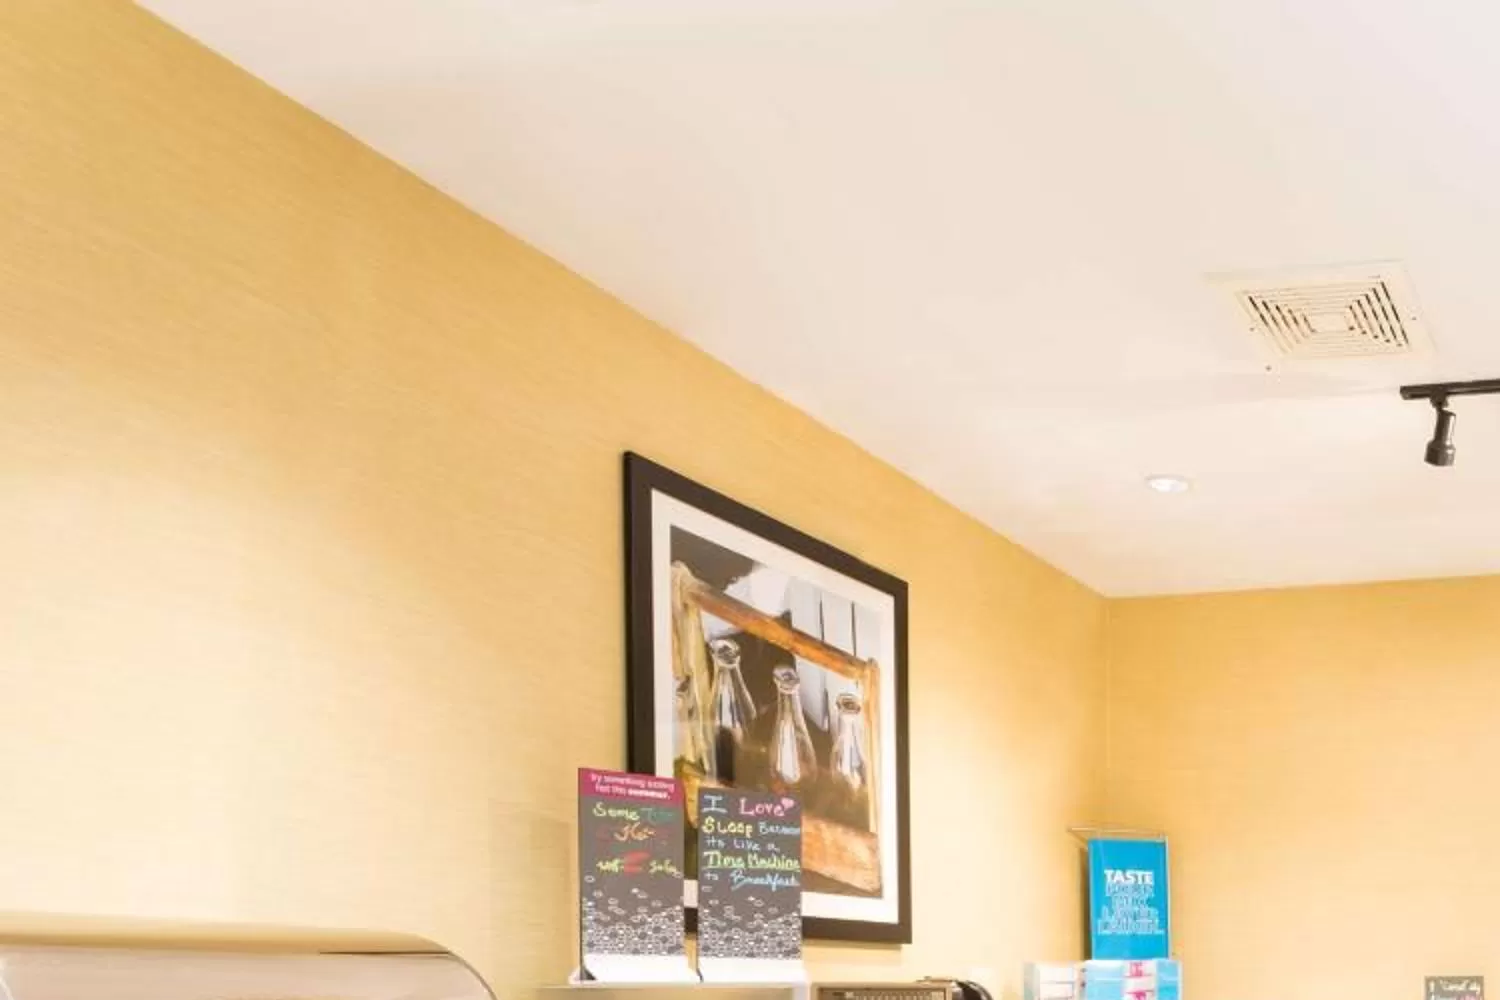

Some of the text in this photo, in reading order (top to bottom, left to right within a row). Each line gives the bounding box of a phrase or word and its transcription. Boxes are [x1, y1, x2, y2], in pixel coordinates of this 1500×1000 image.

[702, 794, 785, 816] I Love
[1104, 870, 1154, 884] TASTE
